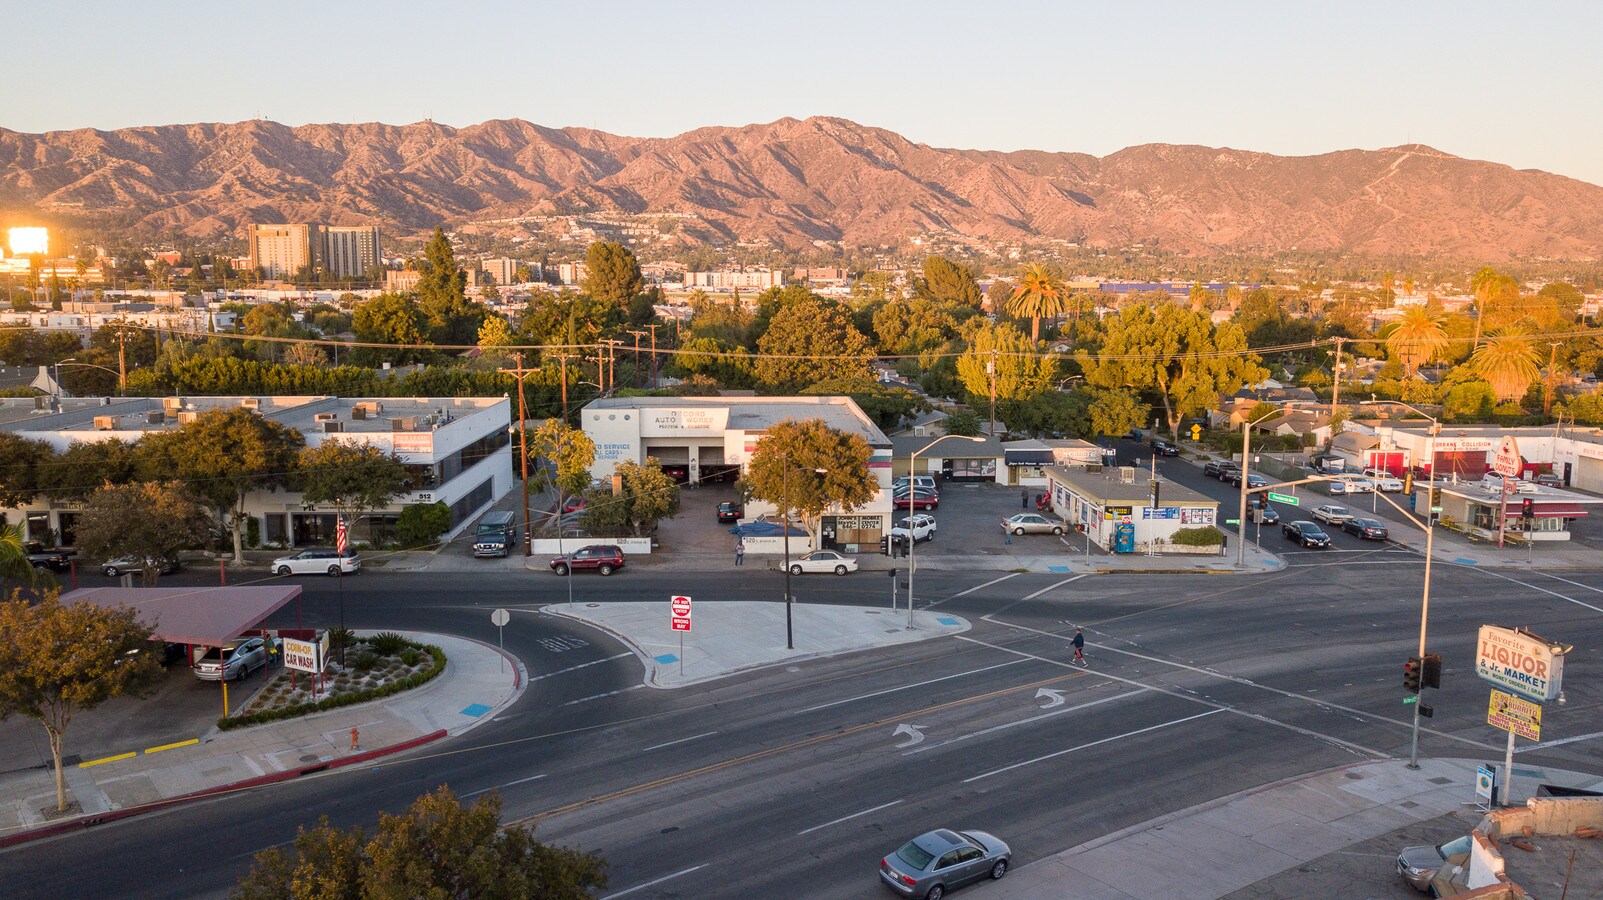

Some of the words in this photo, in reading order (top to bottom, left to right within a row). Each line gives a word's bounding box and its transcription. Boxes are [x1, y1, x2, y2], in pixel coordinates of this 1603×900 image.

[1497, 454, 1516, 465] FAMILY
[1495, 463, 1516, 475] DONUTS
[1488, 631, 1525, 651] Favorite
[285, 652, 298, 666] CAR
[297, 654, 314, 669] WASH
[1481, 640, 1547, 679] LIQUOR
[1480, 658, 1487, 668] &
[1489, 662, 1501, 673] Jr.
[1503, 666, 1547, 690] MARKET
[1491, 672, 1508, 683] MONEY
[1508, 679, 1527, 691] ORDERS
[1530, 687, 1545, 697] GRAM
[1508, 701, 1538, 717] BURRITO
[1495, 711, 1531, 729] QUESADILLAS
[1525, 727, 1539, 737] TACO
